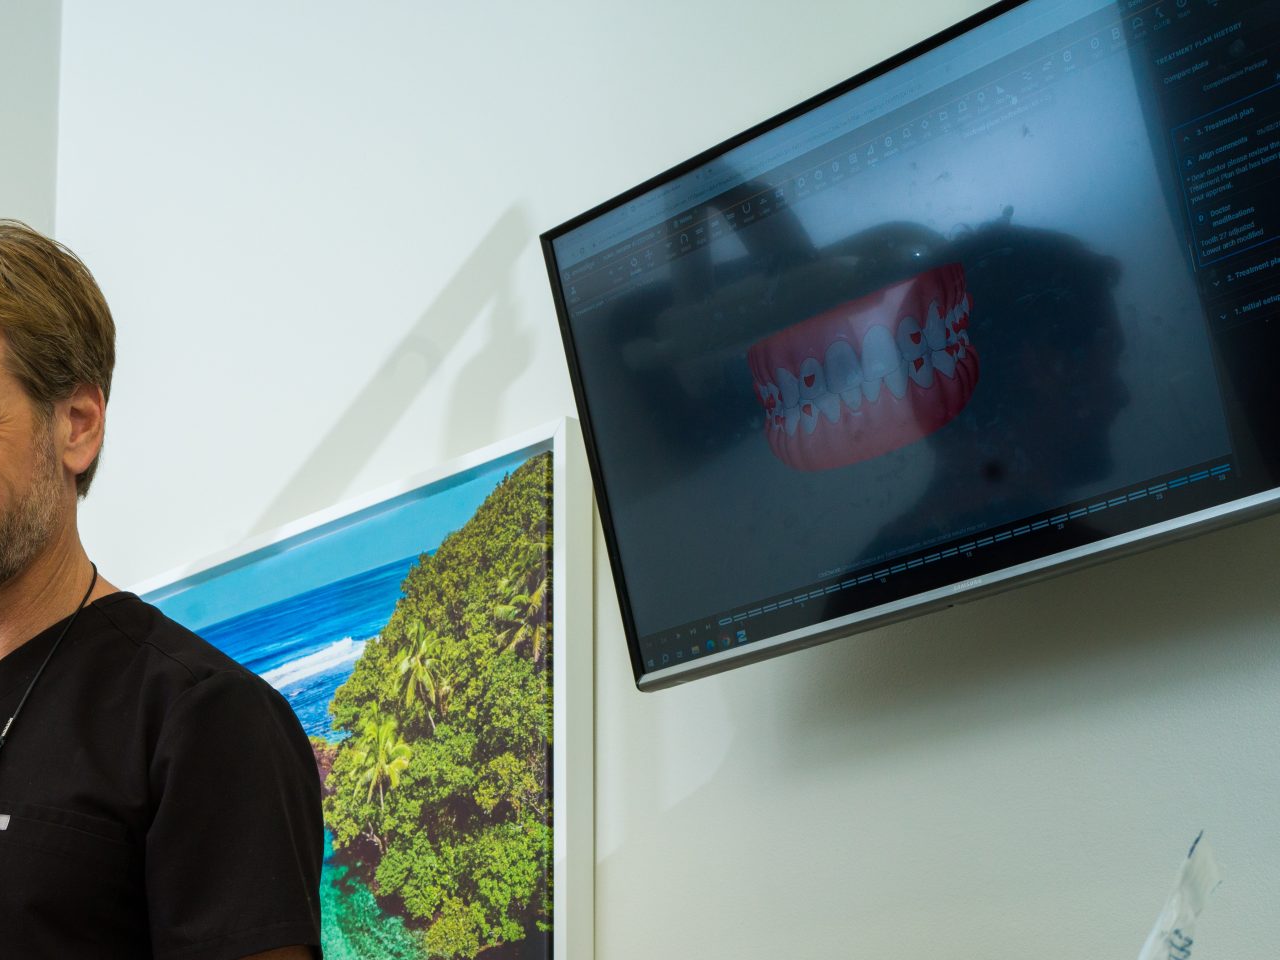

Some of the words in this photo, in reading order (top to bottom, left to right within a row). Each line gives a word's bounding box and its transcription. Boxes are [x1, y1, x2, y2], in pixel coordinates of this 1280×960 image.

[1155, 44, 1193, 64] TREATMENT
[1194, 35, 1213, 48] PLAN
[1213, 21, 1242, 40] HISTORY
[1204, 113, 1238, 133] Treatment
[1239, 107, 1255, 119] plan
[1199, 150, 1215, 161] Align
[1215, 136, 1248, 154] comments
[1210, 204, 1231, 217] Doctor
[1212, 206, 1255, 227] modifications
[1200, 236, 1217, 246] Tooth
[1228, 221, 1255, 237] adjusted
[1202, 244, 1221, 256] Lower
[1222, 240, 1236, 249] arch
[1236, 228, 1264, 243] modified
[1235, 261, 1269, 278] Treatment
